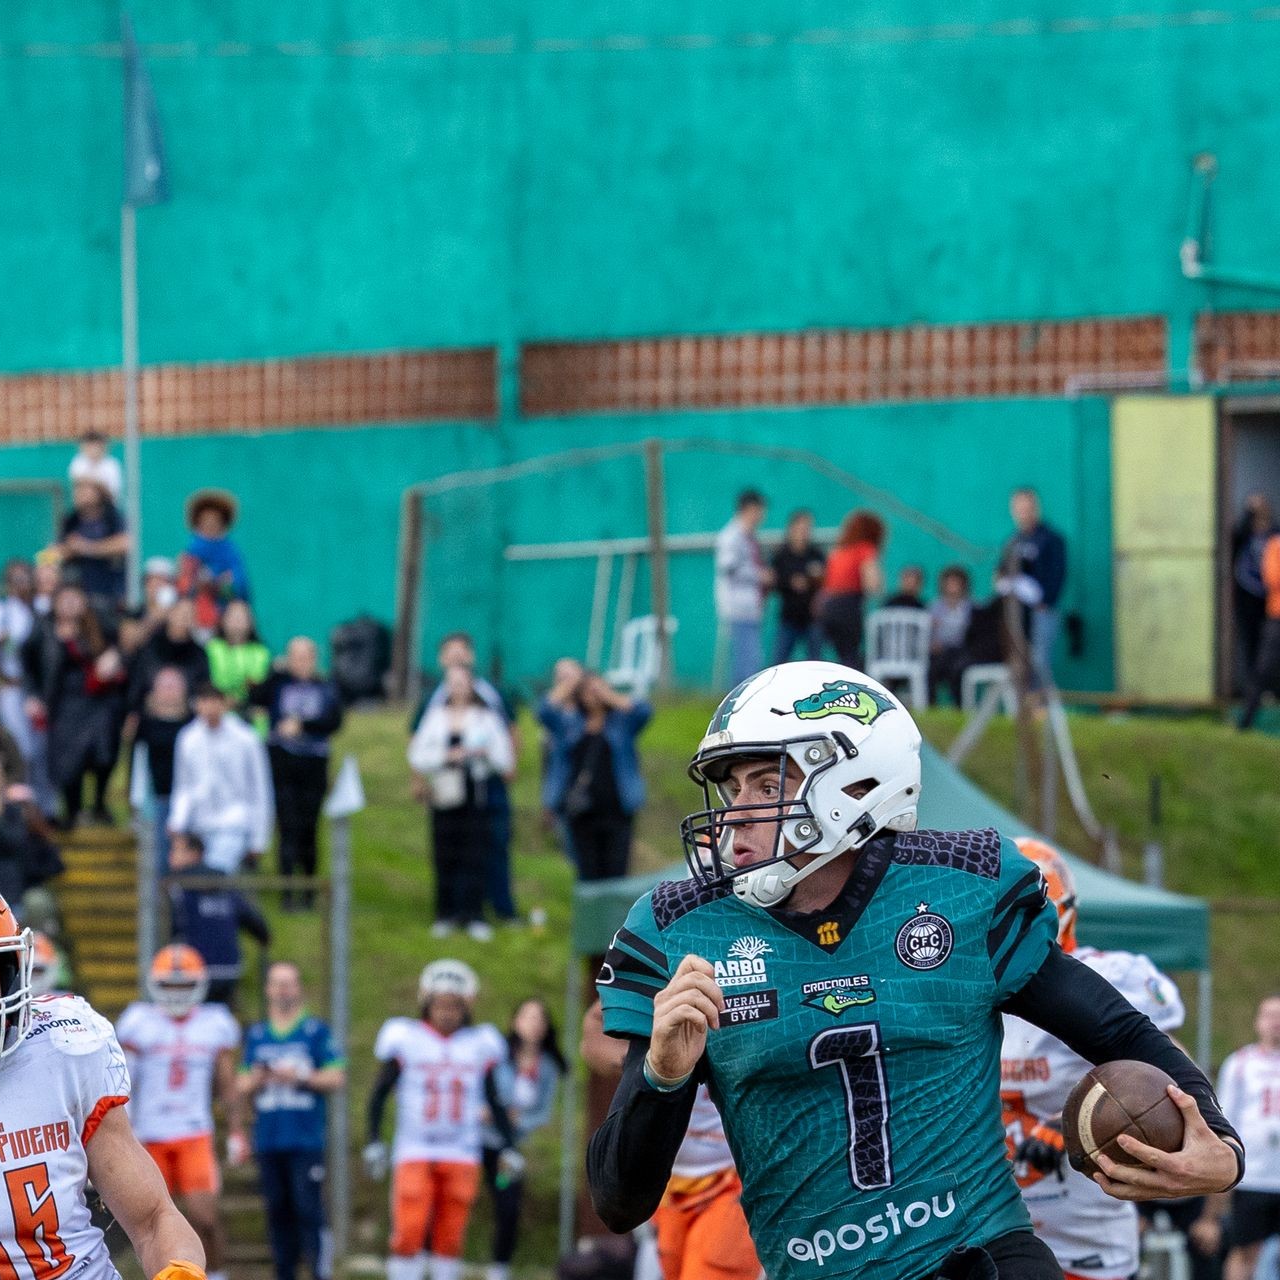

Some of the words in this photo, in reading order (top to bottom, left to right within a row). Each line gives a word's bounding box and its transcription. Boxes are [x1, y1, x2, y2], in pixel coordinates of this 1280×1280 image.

[909, 933, 940, 951] CFC
[714, 957, 766, 978] ARBO
[717, 974, 764, 986] CROSSFIT
[803, 975, 869, 994] CROCODILES
[724, 993, 771, 1009] VERALL
[730, 1008, 760, 1023] GYM
[809, 1022, 893, 1191] 1
[786, 1190, 956, 1266] apostou
